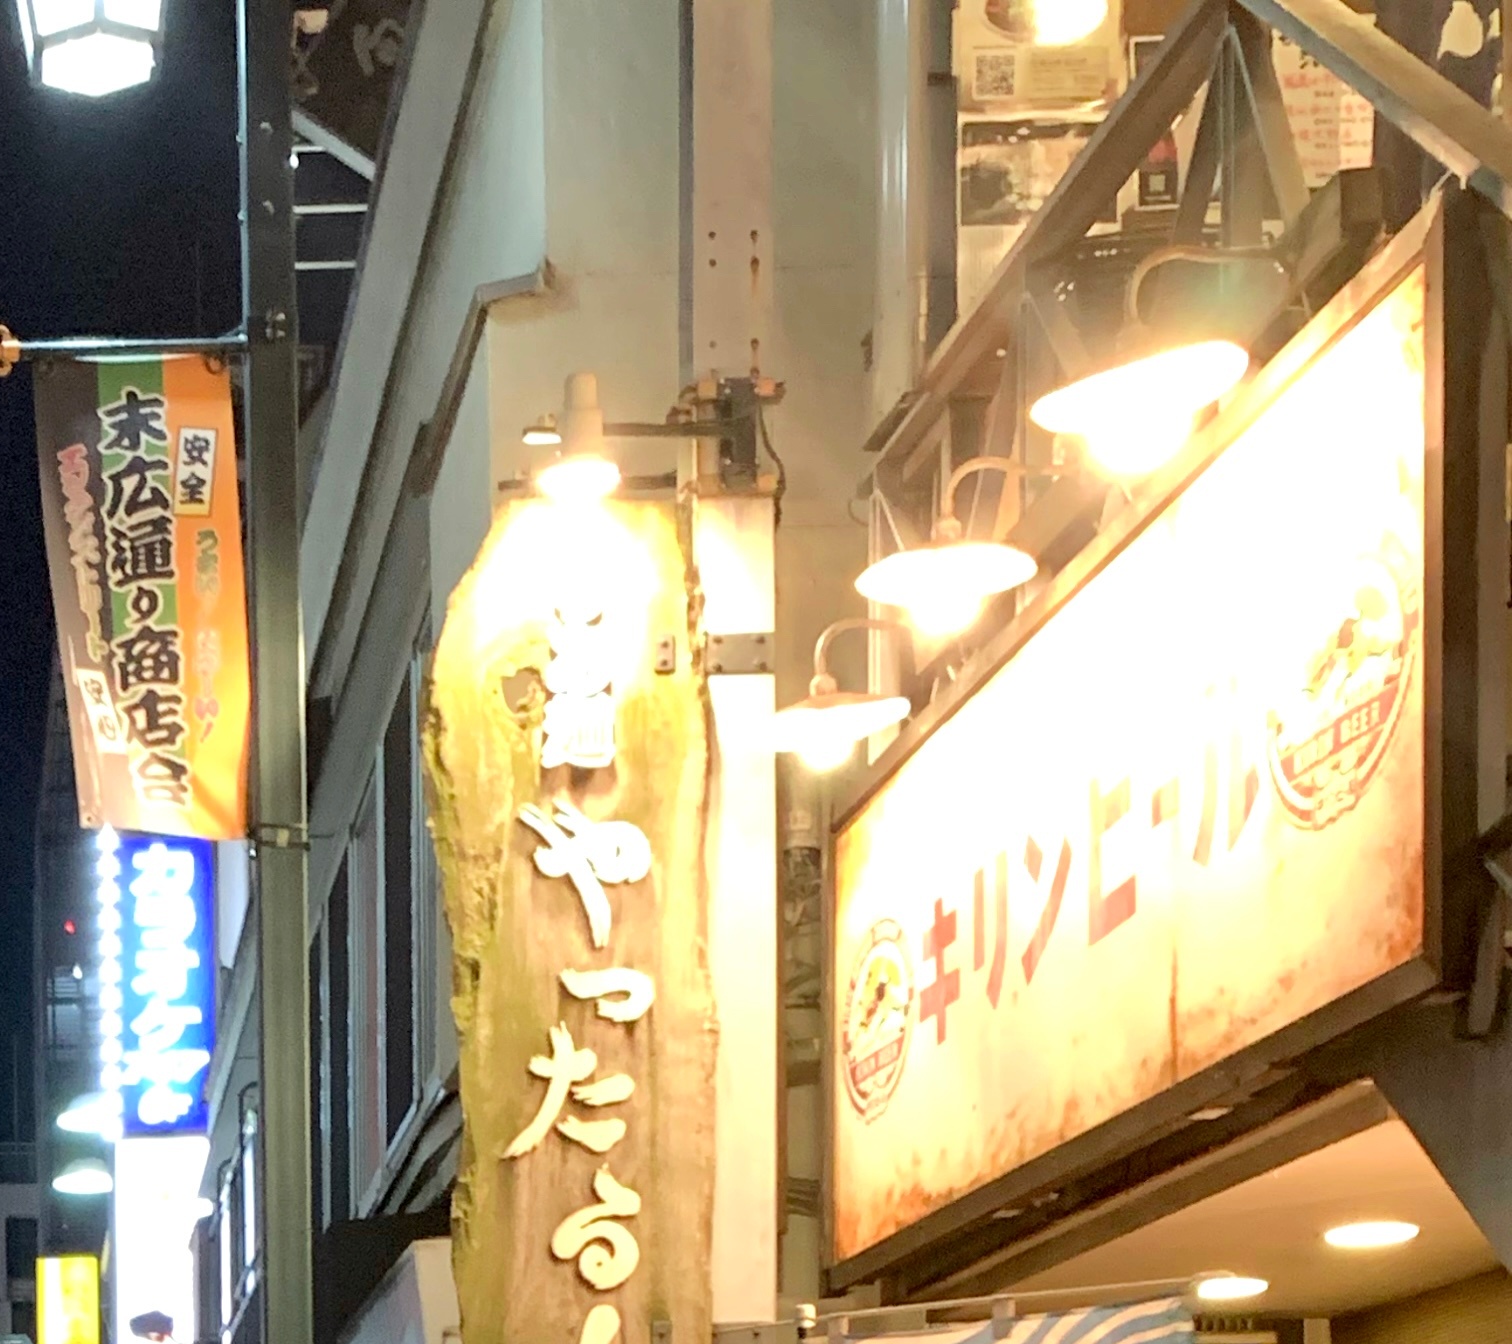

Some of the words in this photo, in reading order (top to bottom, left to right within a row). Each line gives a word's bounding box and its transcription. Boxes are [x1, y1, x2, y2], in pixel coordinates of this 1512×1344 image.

[178, 433, 213, 507] 安全
[95, 385, 191, 808] 末広通り商店会
